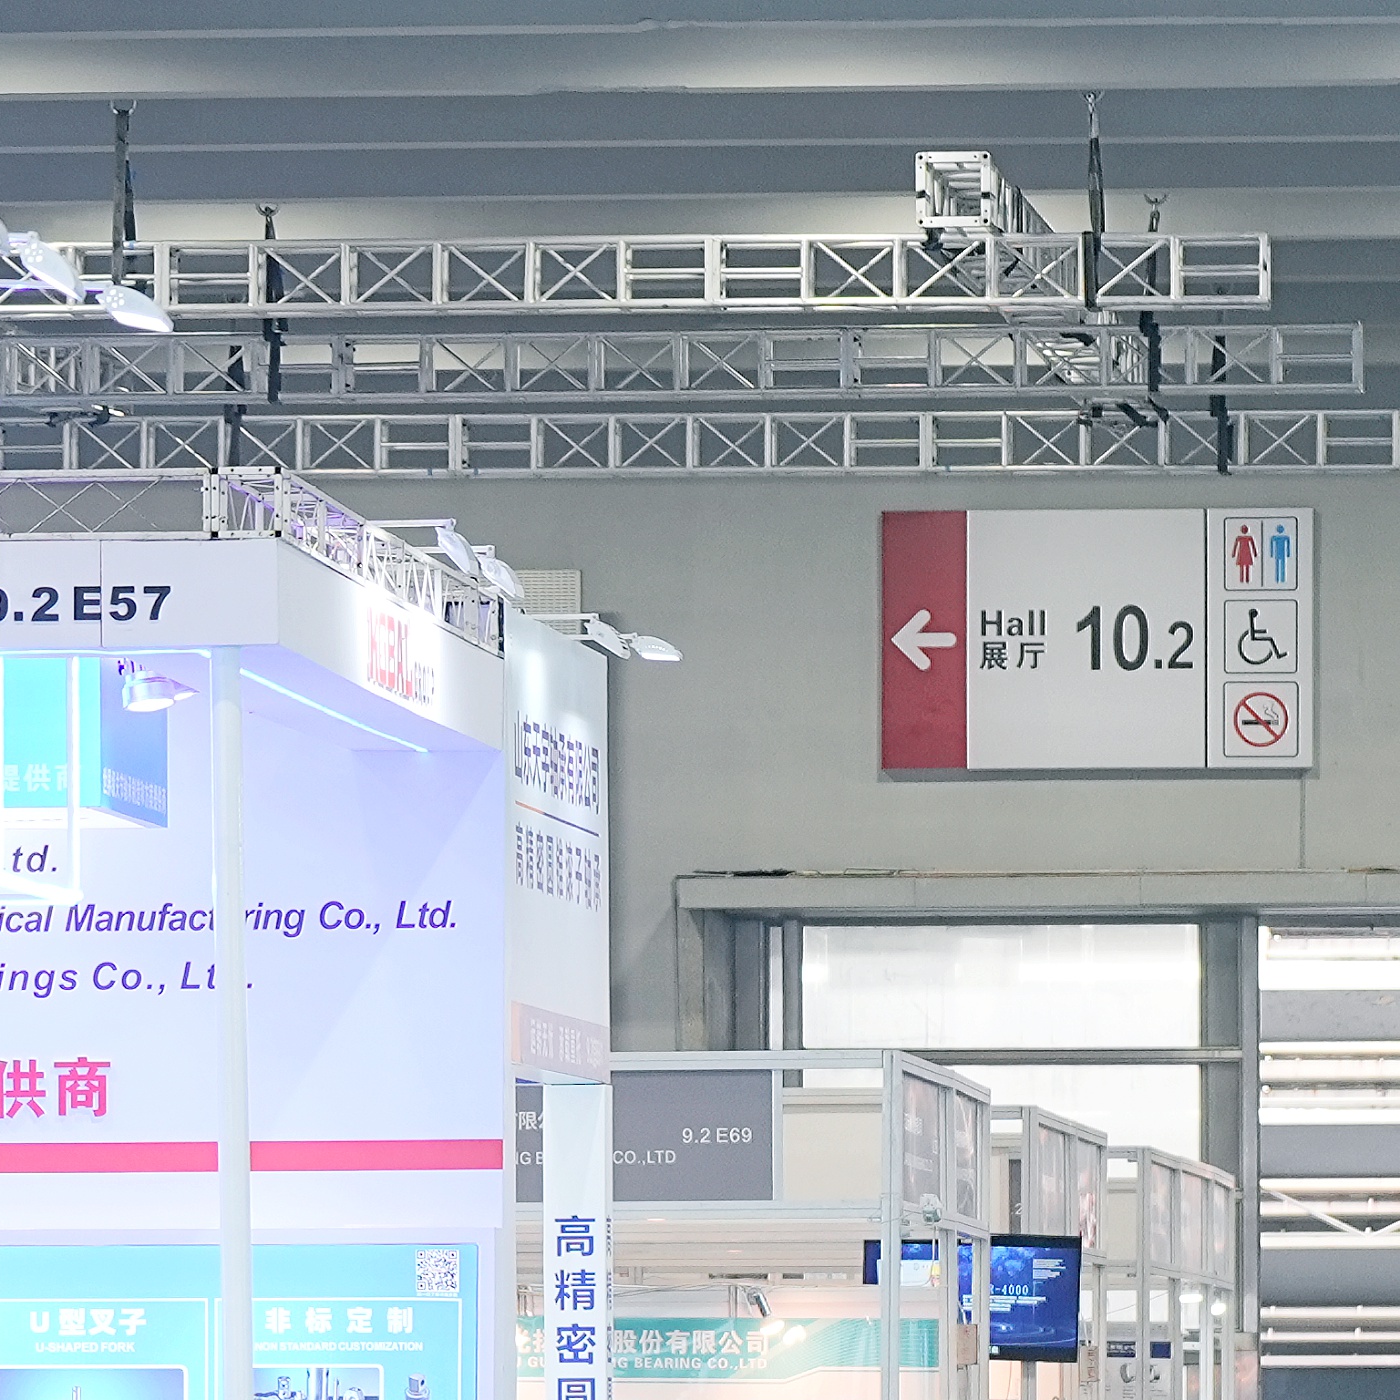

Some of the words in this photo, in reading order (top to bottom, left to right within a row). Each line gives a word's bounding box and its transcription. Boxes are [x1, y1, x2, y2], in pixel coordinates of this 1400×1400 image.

[979, 609, 1048, 637] Hall
[1076, 604, 1195, 672] 10.2
[979, 641, 1048, 670] 展厅
[65, 902, 305, 938] Manufactring
[319, 900, 382, 935] Co.,
[395, 900, 458, 930] Ltd.
[91, 961, 167, 995] Co.,
[179, 961, 255, 991] Lt.
[681, 1126, 712, 1145] 9.2
[715, 1127, 753, 1145] E69
[264, 1306, 415, 1334] 非标定制
[34, 1341, 99, 1354] U-SHAPED
[100, 1341, 136, 1354] FORK
[634, 1357, 702, 1370] BEARING
